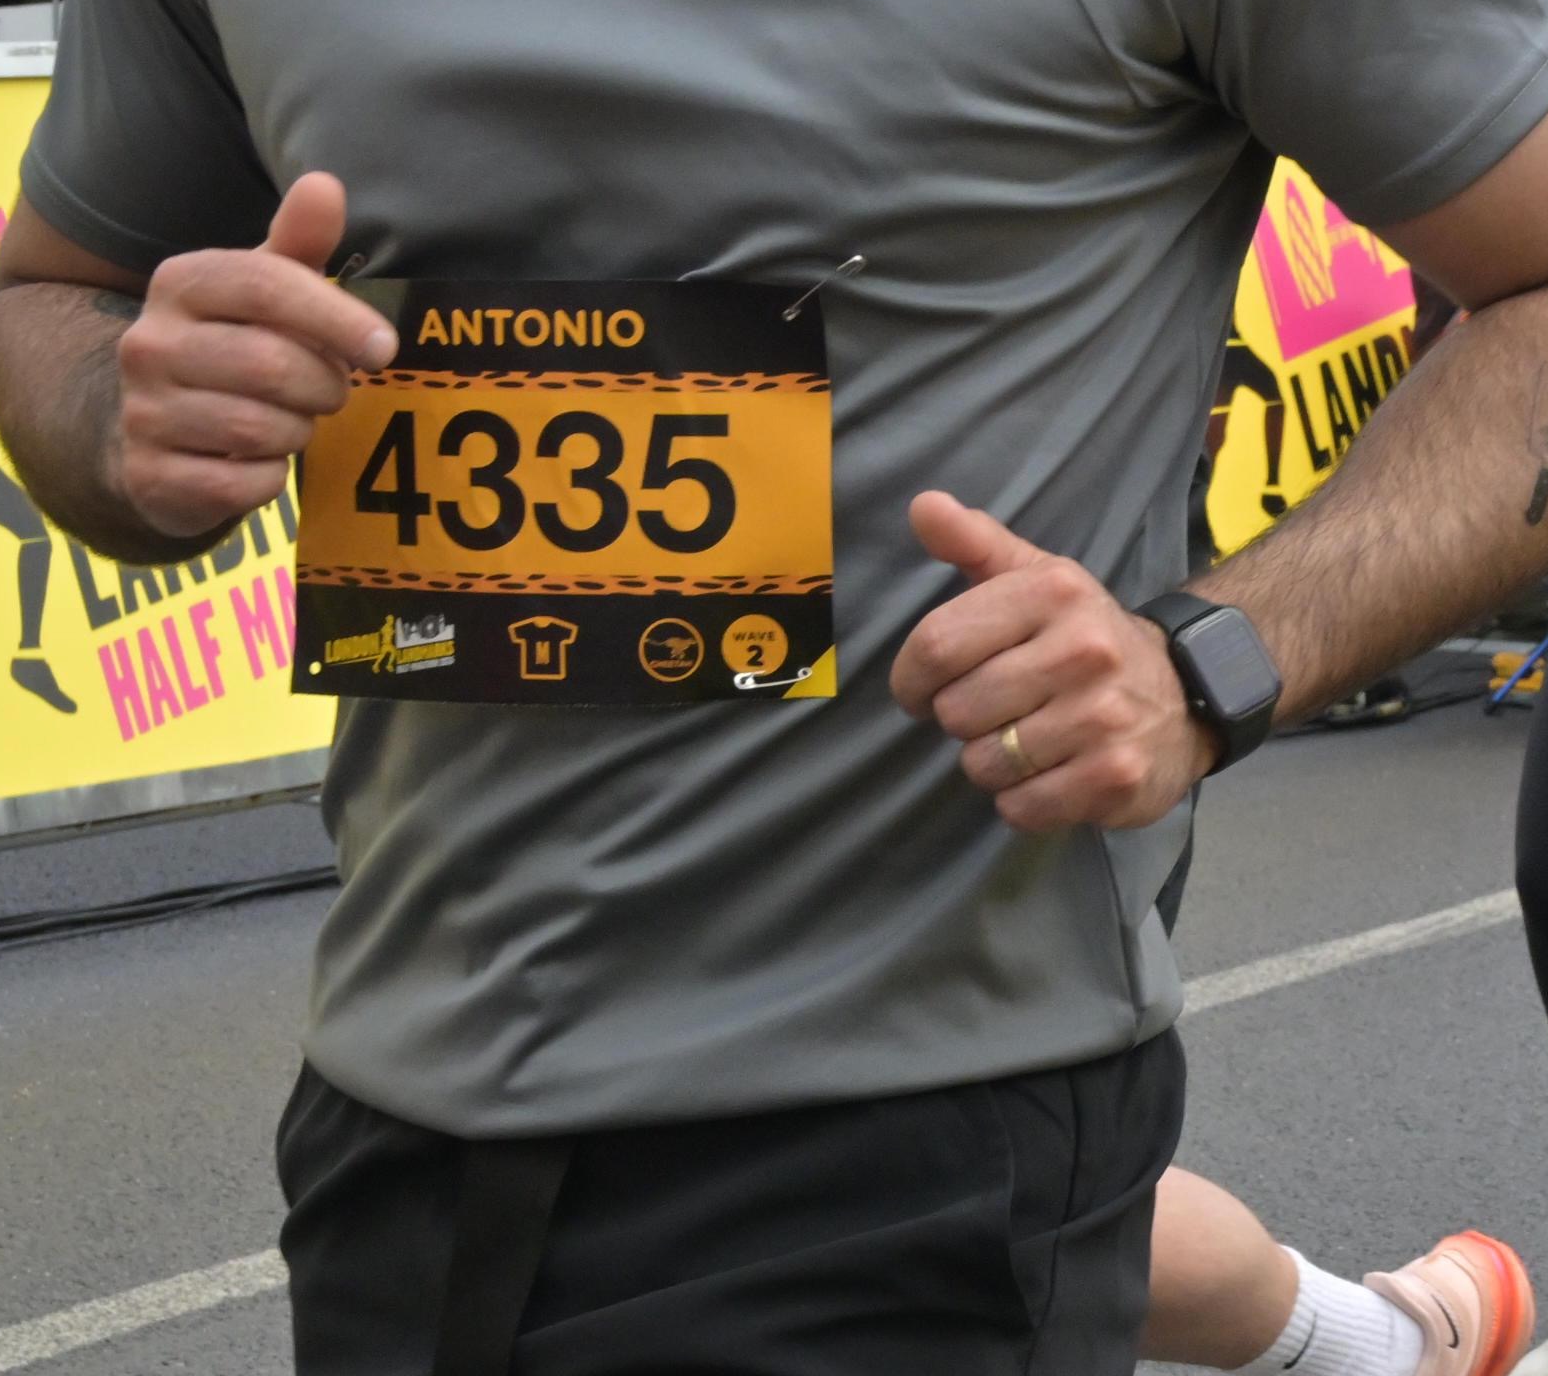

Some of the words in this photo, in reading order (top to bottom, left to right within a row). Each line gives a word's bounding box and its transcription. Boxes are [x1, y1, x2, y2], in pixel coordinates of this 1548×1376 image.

[417, 308, 645, 347] ANTONIO
[355, 409, 737, 554] 4335
[733, 630, 777, 642] WAVE
[747, 644, 764, 667] 2
[98, 600, 225, 742] HALF
